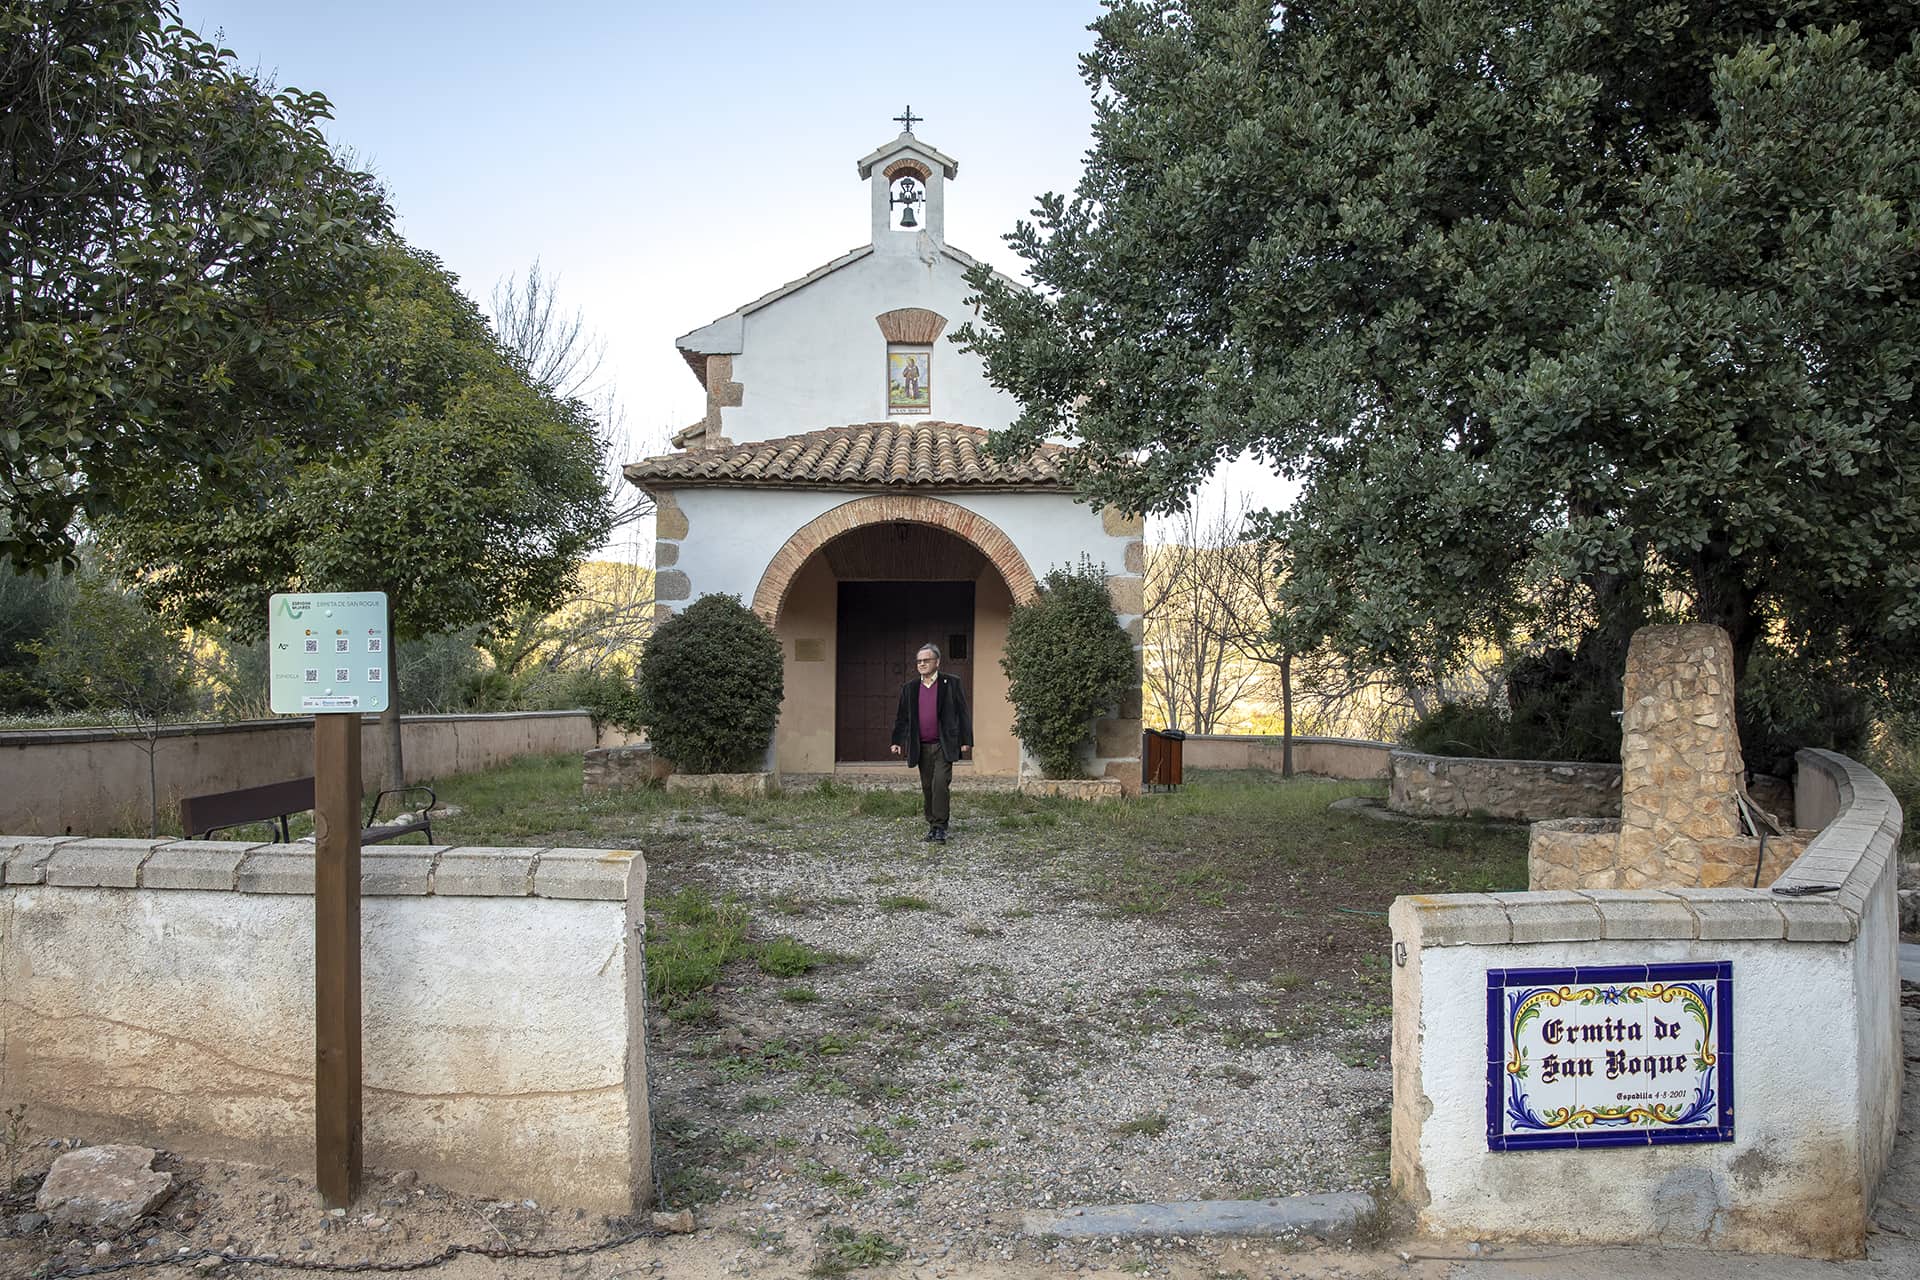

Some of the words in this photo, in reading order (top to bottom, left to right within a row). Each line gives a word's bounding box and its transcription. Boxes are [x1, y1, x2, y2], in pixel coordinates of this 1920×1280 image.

[1541, 1016, 1642, 1045] Ermita
[1654, 1016, 1682, 1041] de
[1541, 1053, 1594, 1084] San
[1605, 1049, 1688, 1081] Roque
[1616, 1092, 1653, 1102] Espadilla
[1653, 1089, 1688, 1100] 4-8-2001
